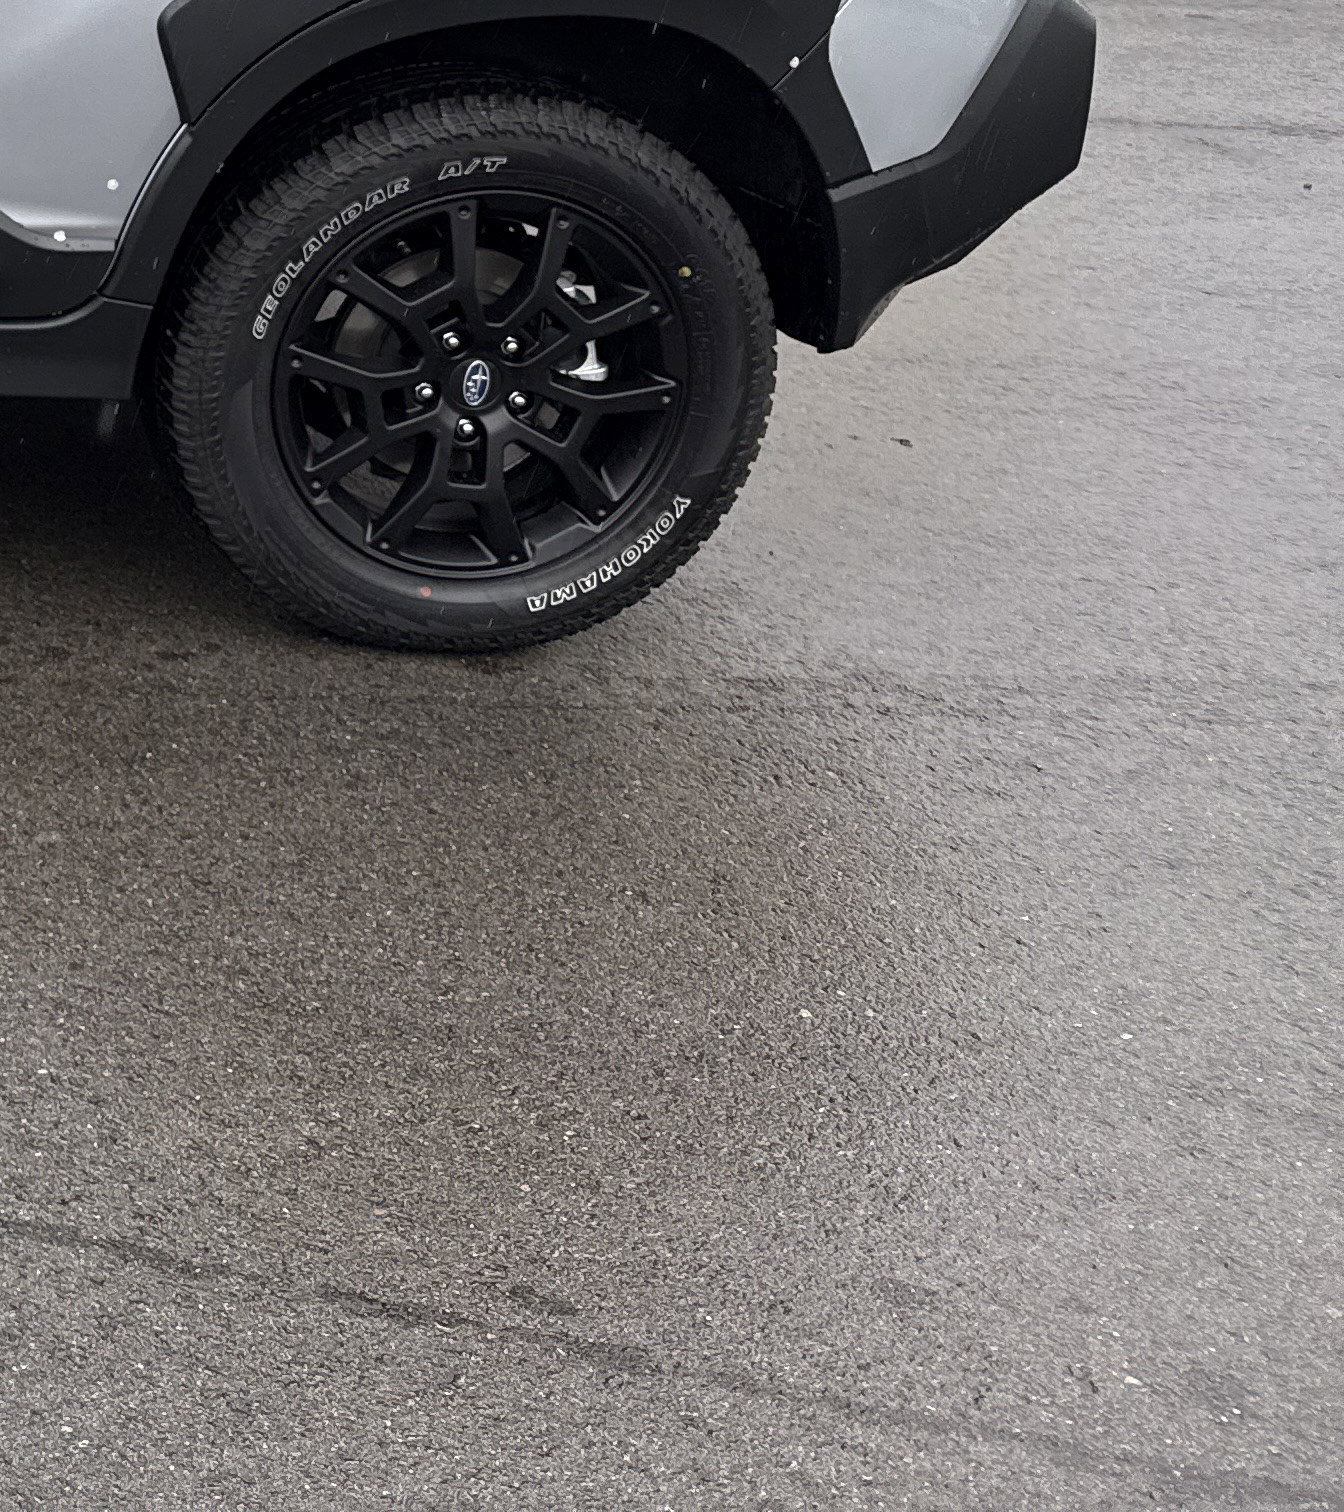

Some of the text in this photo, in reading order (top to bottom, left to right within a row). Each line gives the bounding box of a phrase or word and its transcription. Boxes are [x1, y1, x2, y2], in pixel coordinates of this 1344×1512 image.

[252, 156, 507, 340] GEOLANDAR A/T
[527, 495, 692, 612] YOKOHAMA
